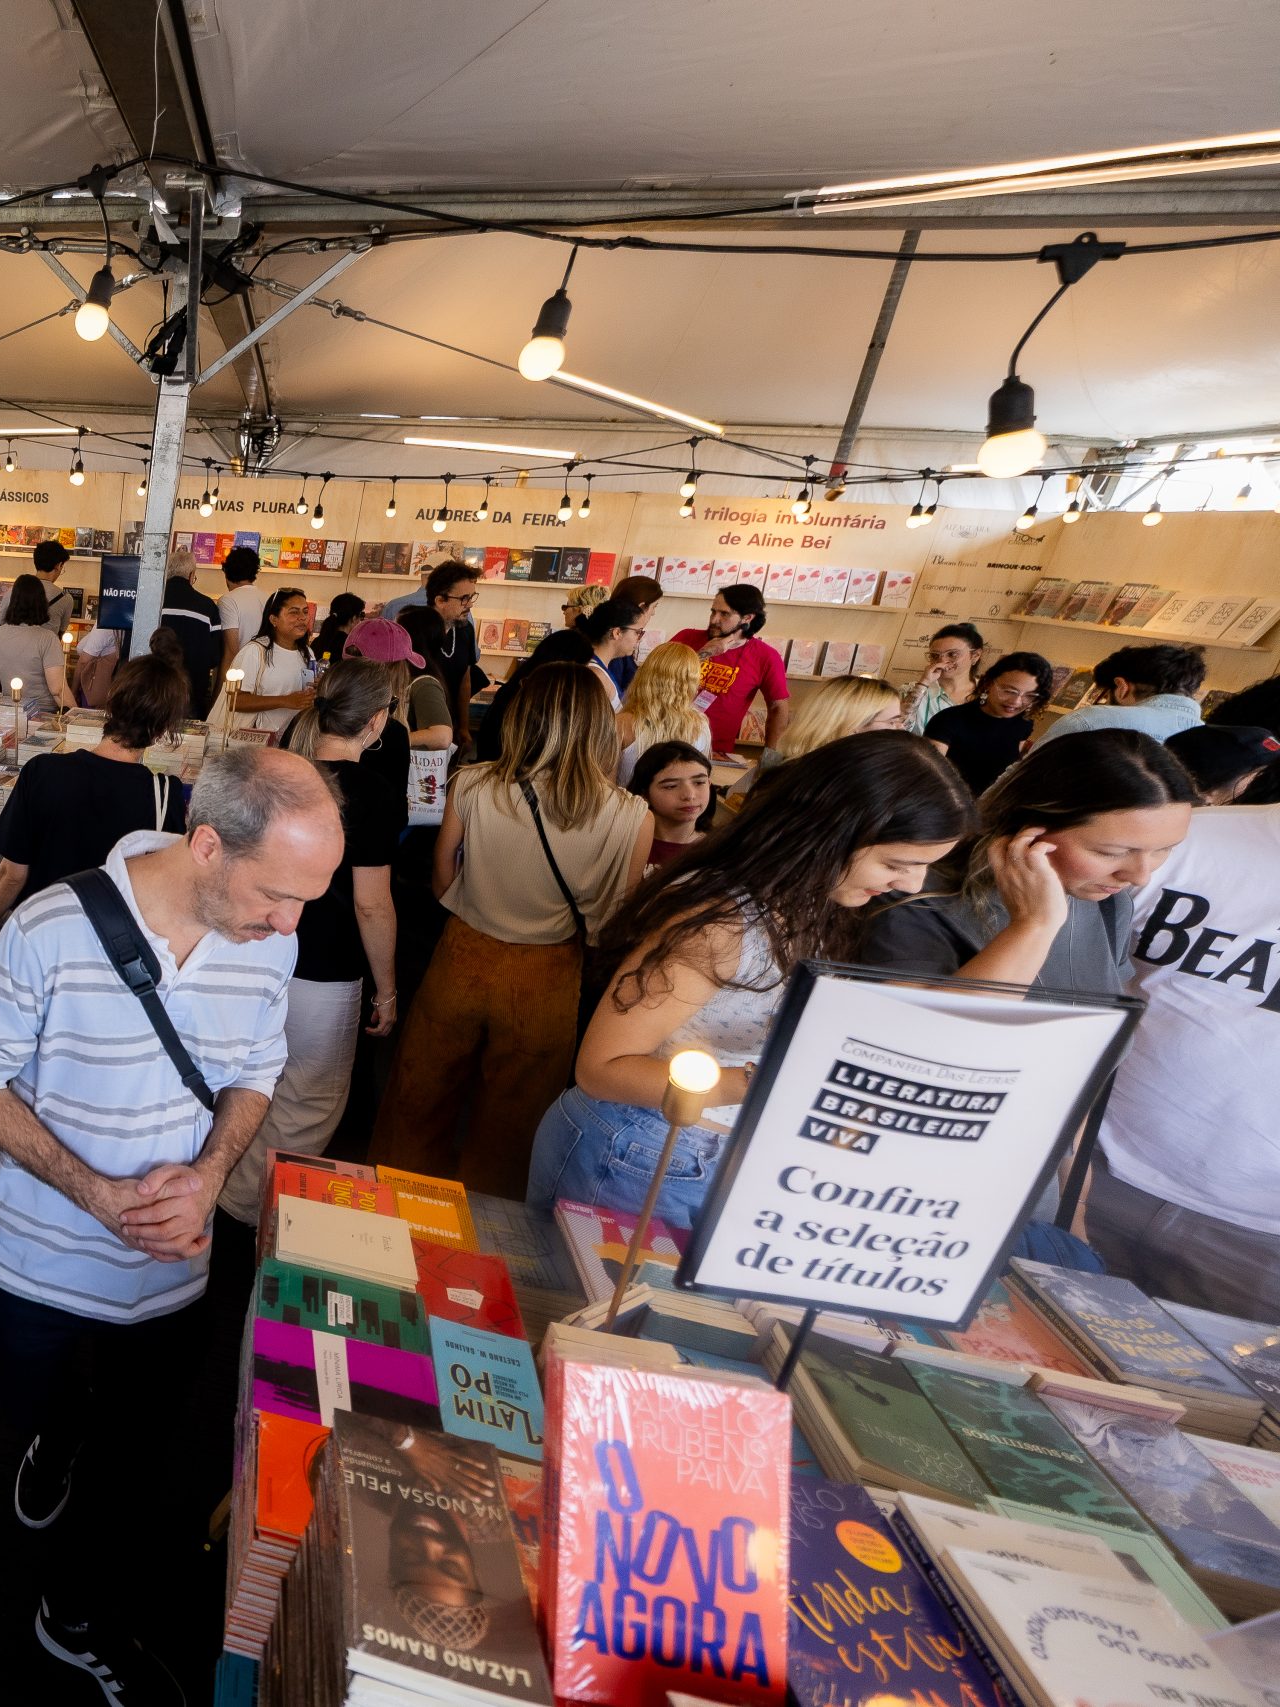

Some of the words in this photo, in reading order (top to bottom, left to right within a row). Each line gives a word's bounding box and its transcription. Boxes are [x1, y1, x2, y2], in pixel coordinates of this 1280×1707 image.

[492, 511, 512, 524] DA
[522, 513, 567, 527] FEIRA
[704, 507, 767, 526] trilogia
[775, 508, 886, 530] involuntária
[719, 532, 741, 546] de
[748, 533, 794, 548] Aline
[801, 535, 832, 550] Bei
[986, 562, 1042, 572] BRINQUE-BOOK
[103, 588, 118, 597] NÃO
[120, 590, 137, 599] FICÇ
[922, 583, 967, 594] claroenigma
[835, 1066, 1000, 1112] LITERATURA
[821, 1094, 983, 1140] BRASILEIRA
[809, 1121, 871, 1151] VIVA
[398, 1191, 454, 1208] JANELAS
[777, 1165, 960, 1219] Confira
[753, 1209, 784, 1233] a
[793, 1223, 970, 1263] seleção
[735, 1242, 793, 1275] de
[801, 1257, 949, 1296] títulos
[445, 1340, 475, 1355] GALINDO
[489, 1353, 520, 1367] CAETANO
[450, 1363, 493, 1396] PÓ
[454, 1394, 544, 1445] LATIM
[630, 1390, 766, 1440] ARCELO
[639, 1419, 768, 1470] RUBENS
[344, 1470, 391, 1495] PELE
[594, 1439, 644, 1516] O
[676, 1454, 768, 1499] PAIVA
[398, 1484, 467, 1514] NOSSA
[472, 1502, 502, 1521] NA
[595, 1509, 759, 1609] NOVO
[362, 1623, 437, 1661] RAMOS
[572, 1579, 771, 1688] AGORA
[442, 1650, 532, 1688] LÁZARO
